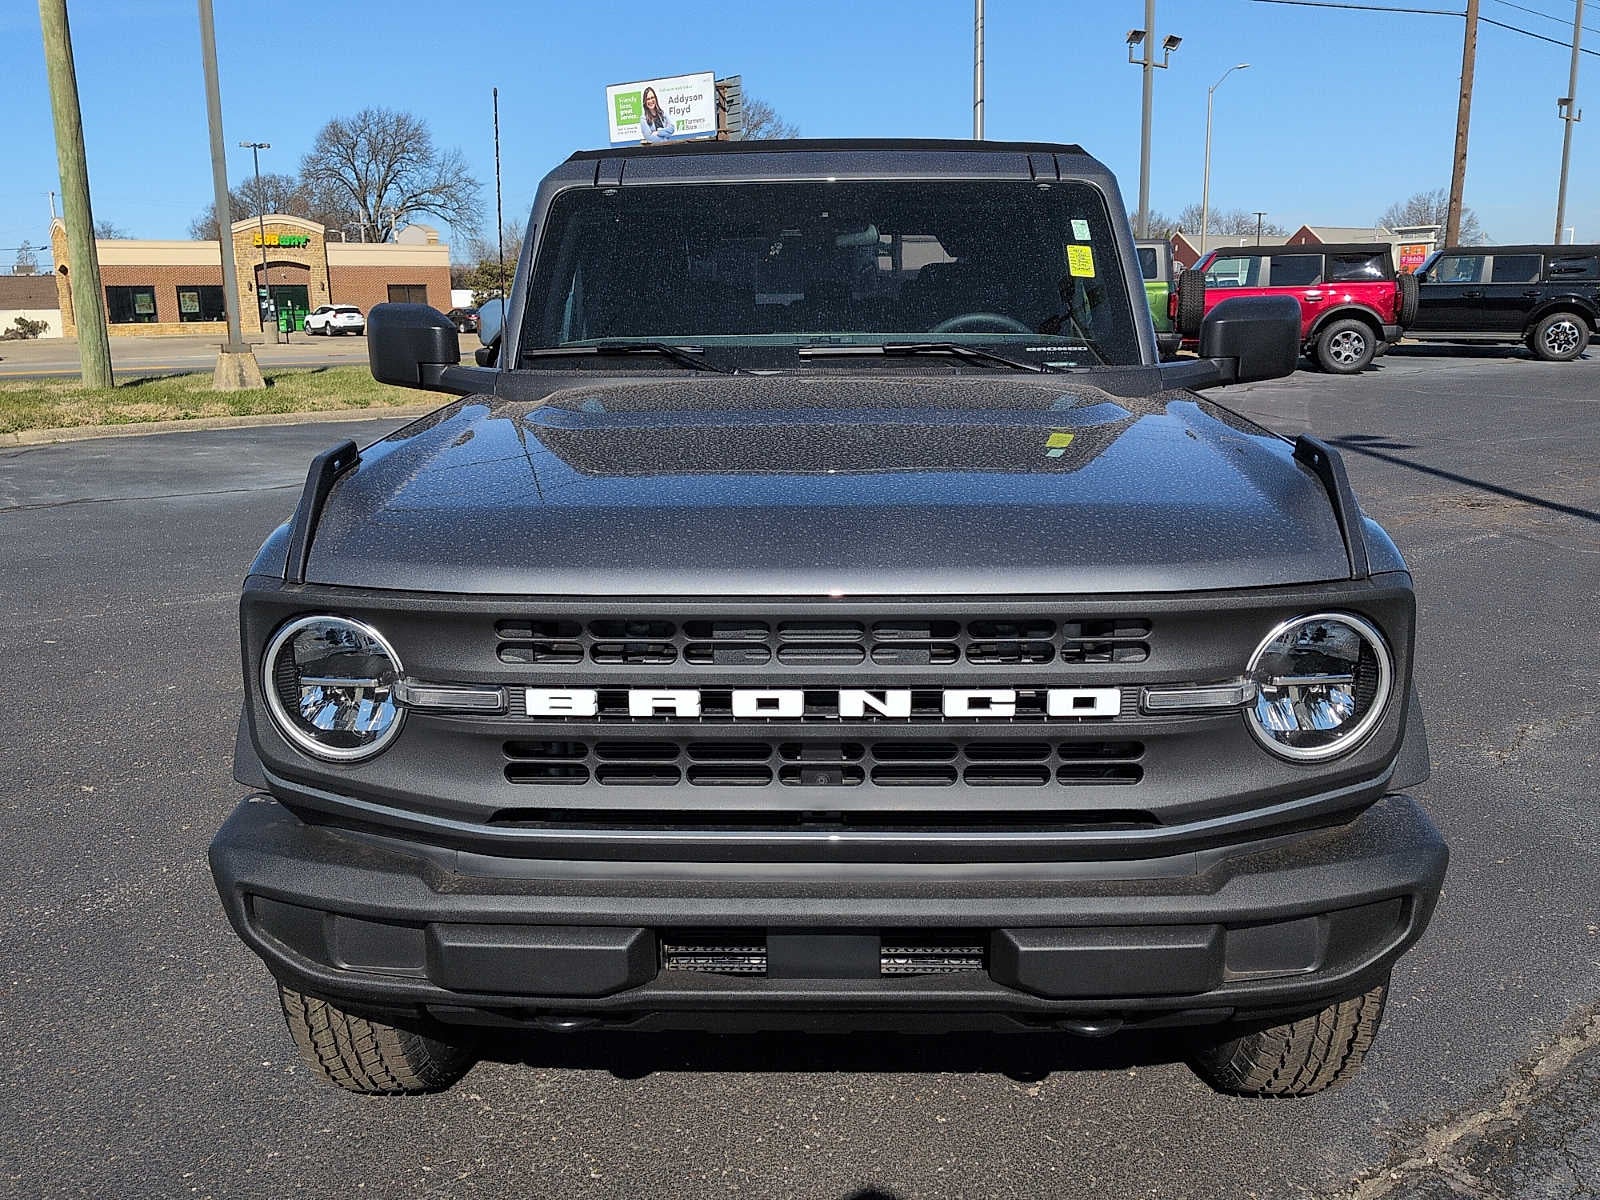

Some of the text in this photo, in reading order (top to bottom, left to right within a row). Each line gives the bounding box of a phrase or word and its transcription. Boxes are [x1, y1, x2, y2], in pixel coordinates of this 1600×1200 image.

[668, 93, 703, 104] Addyson
[669, 104, 691, 116] Floyd
[253, 234, 311, 246] SUBWAY
[525, 688, 1121, 719] BRONCO
